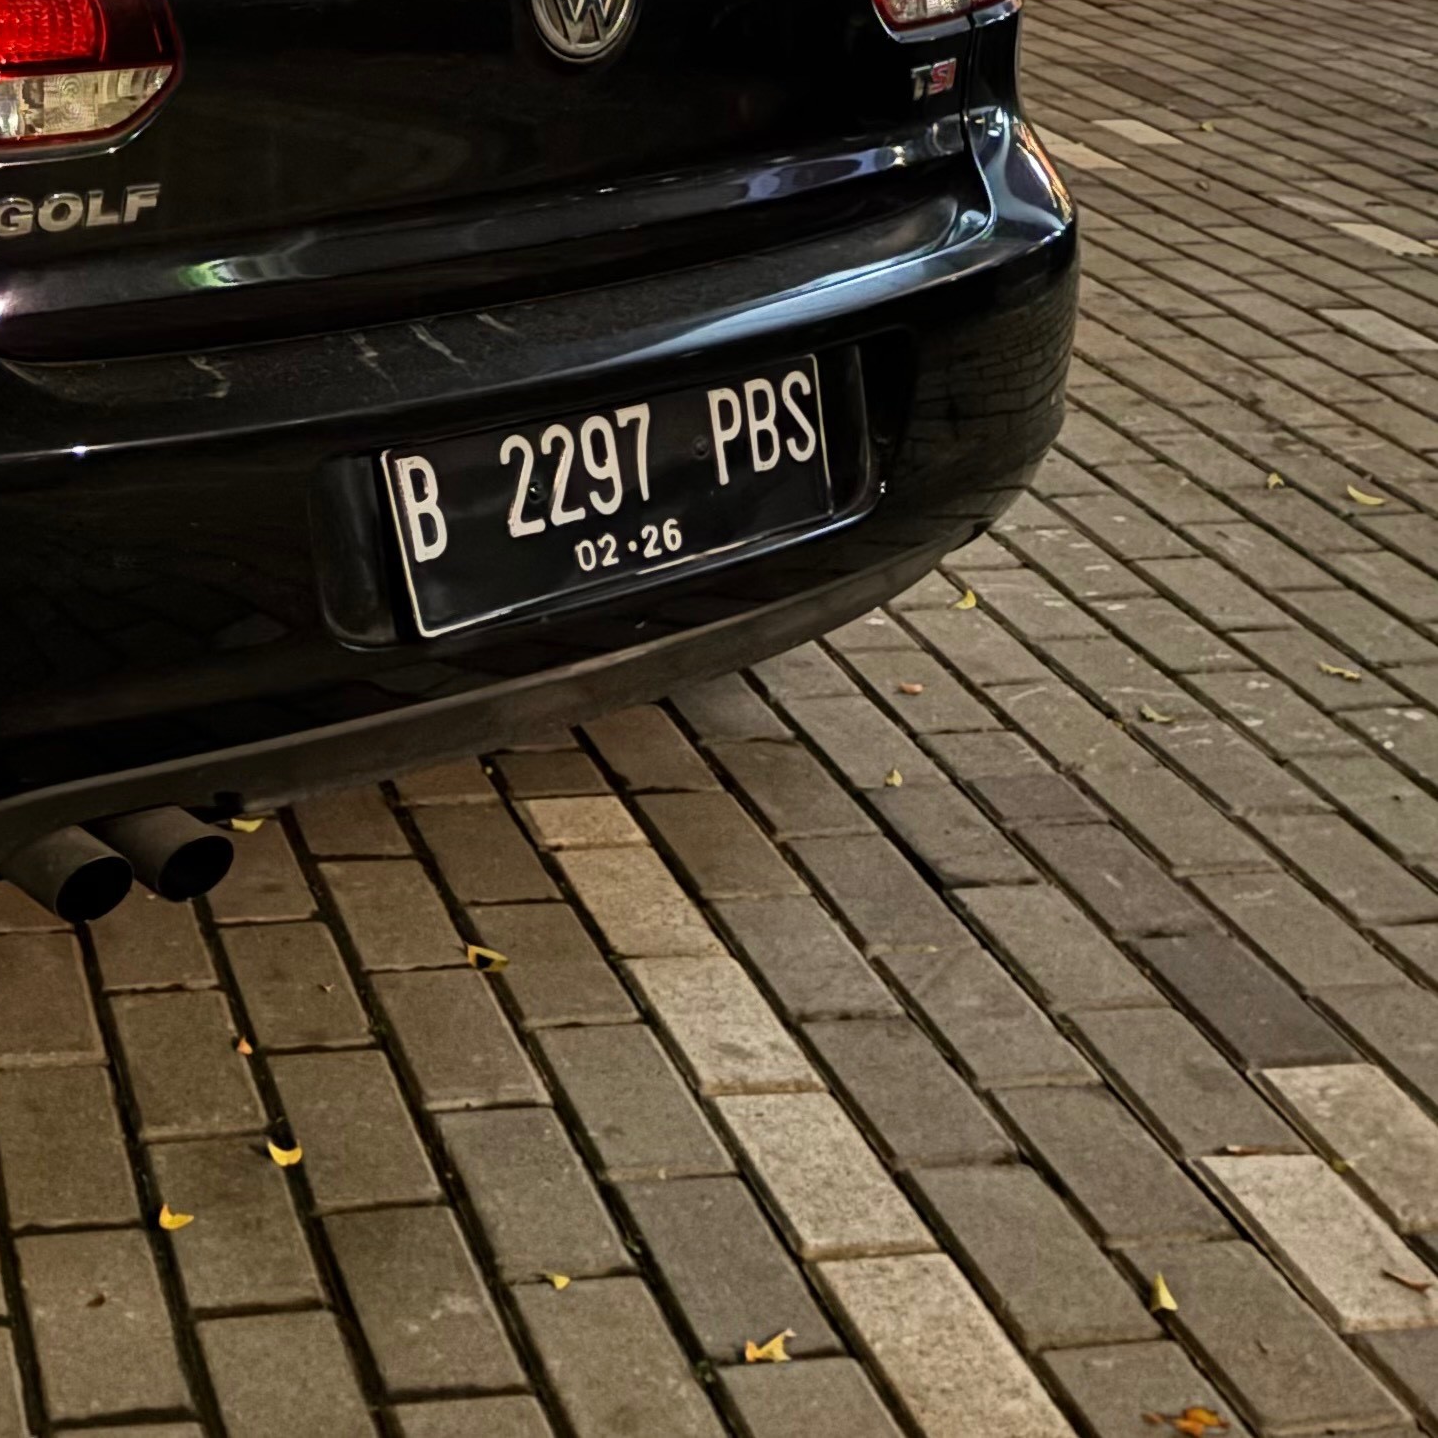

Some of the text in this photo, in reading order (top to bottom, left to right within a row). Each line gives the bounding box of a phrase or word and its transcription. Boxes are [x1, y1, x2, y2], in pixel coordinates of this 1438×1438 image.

[910, 57, 957, 101] TSI
[394, 369, 817, 563] B 2297 PBS
